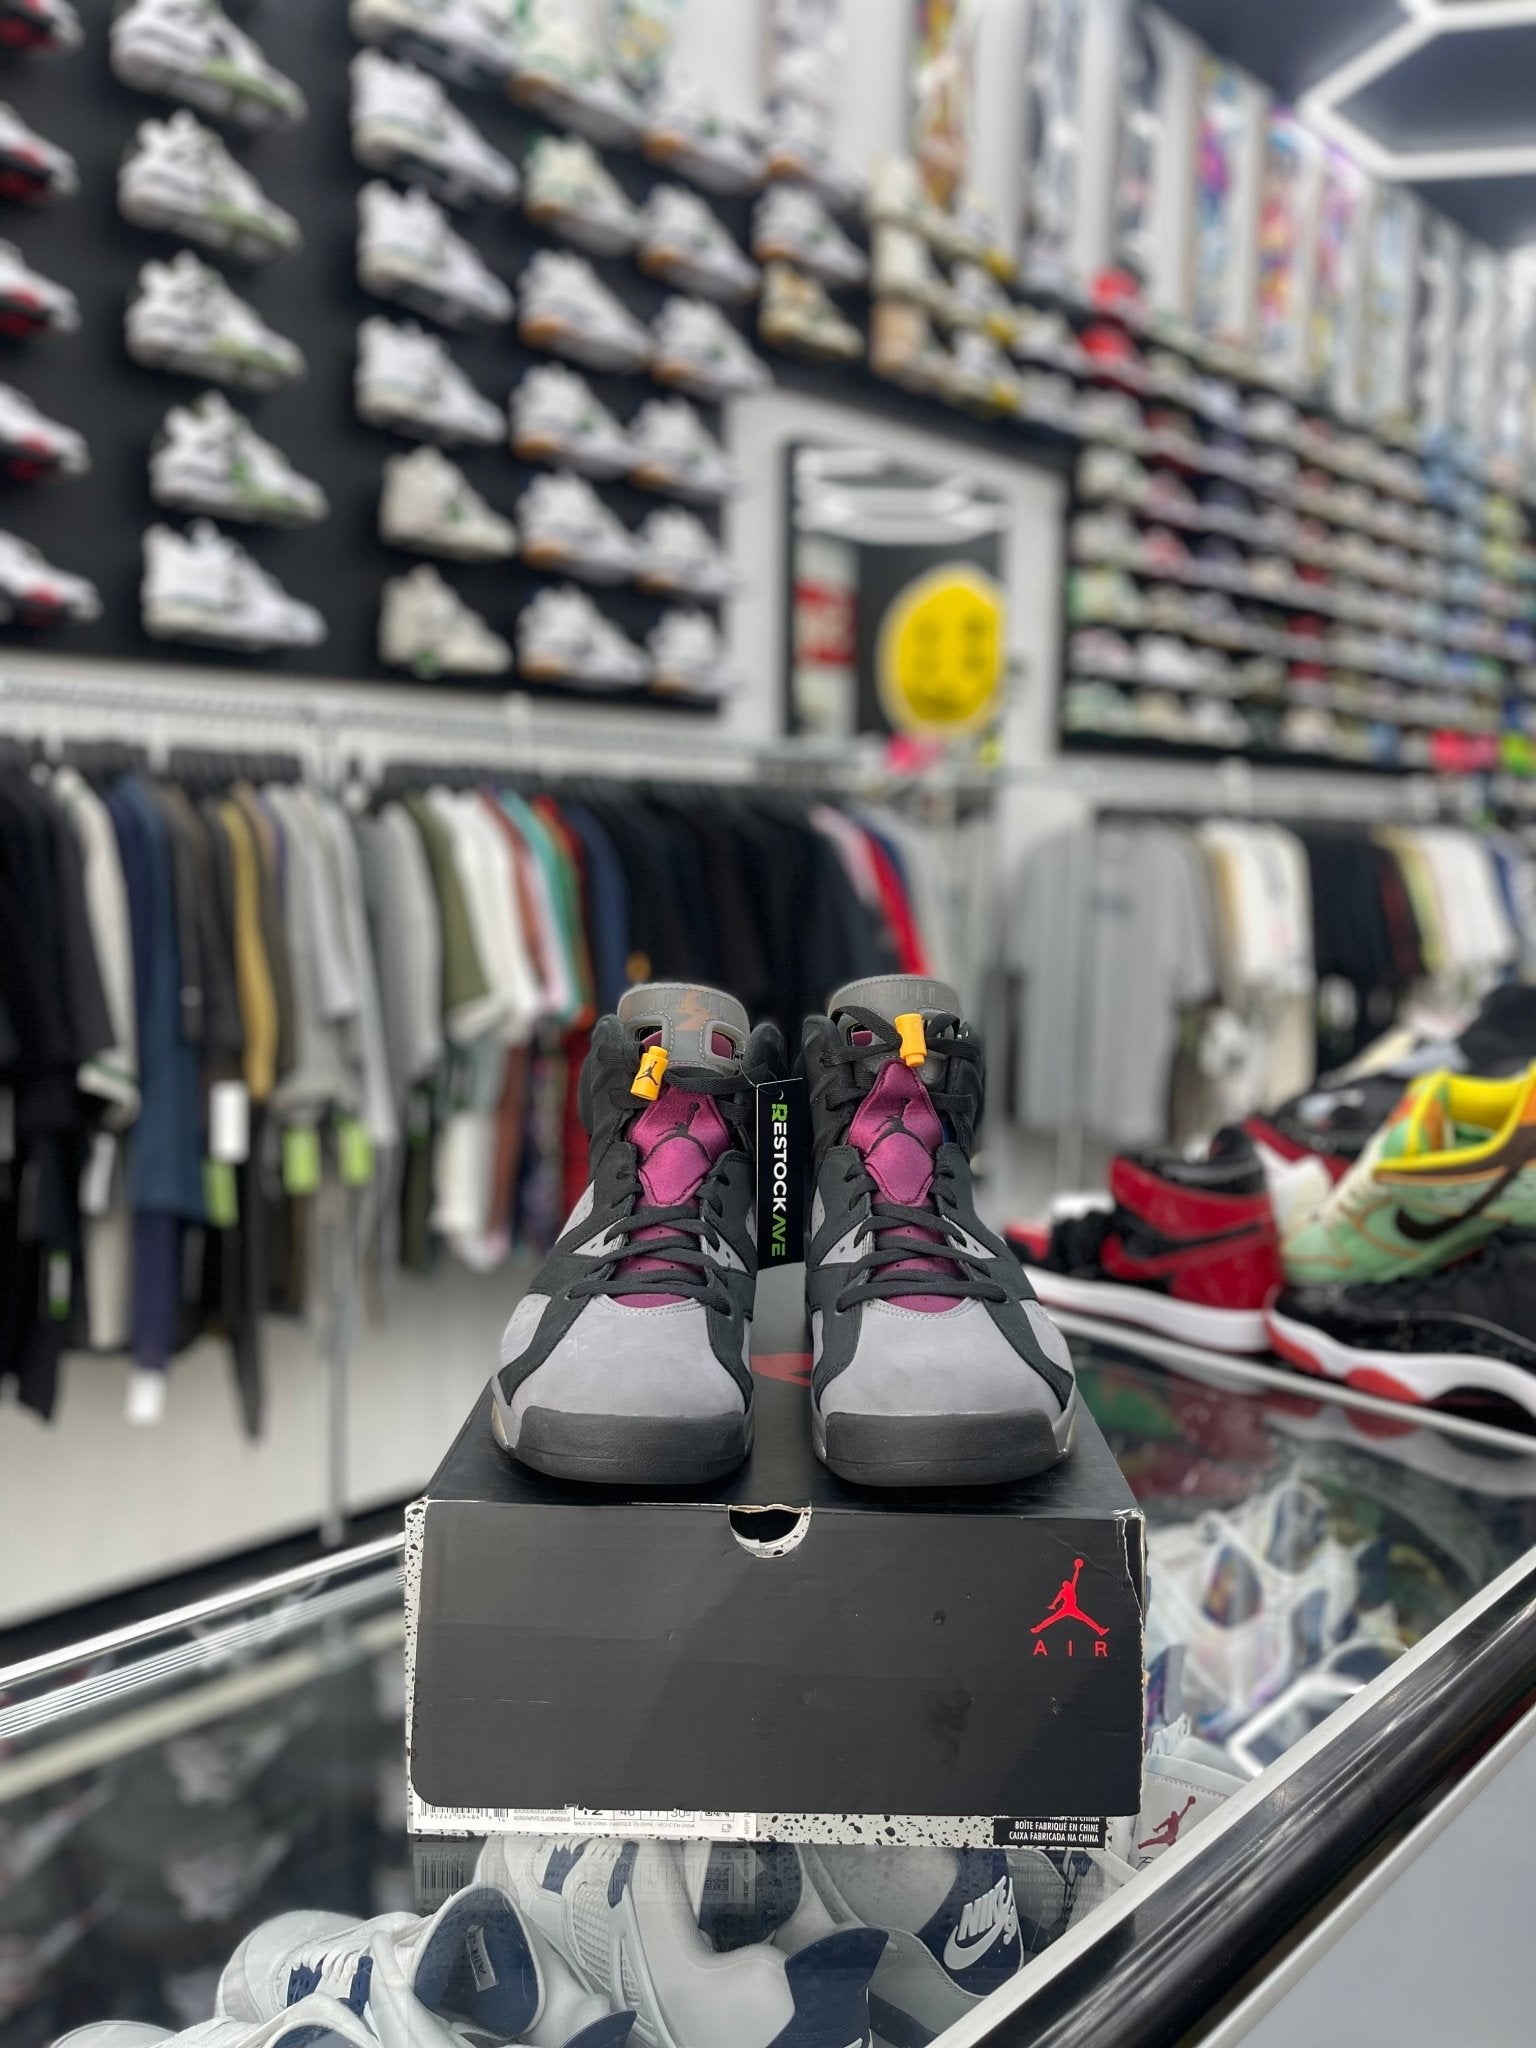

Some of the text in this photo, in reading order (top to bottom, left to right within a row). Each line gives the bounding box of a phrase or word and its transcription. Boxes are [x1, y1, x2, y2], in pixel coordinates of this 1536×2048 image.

[1033, 1639, 1108, 1657] AIR
[1069, 1822, 1078, 1832] EN
[1079, 1823, 1099, 1833] CHINE
[1009, 1831, 1099, 1843] CAIXA FABRICADA NA CHINA
